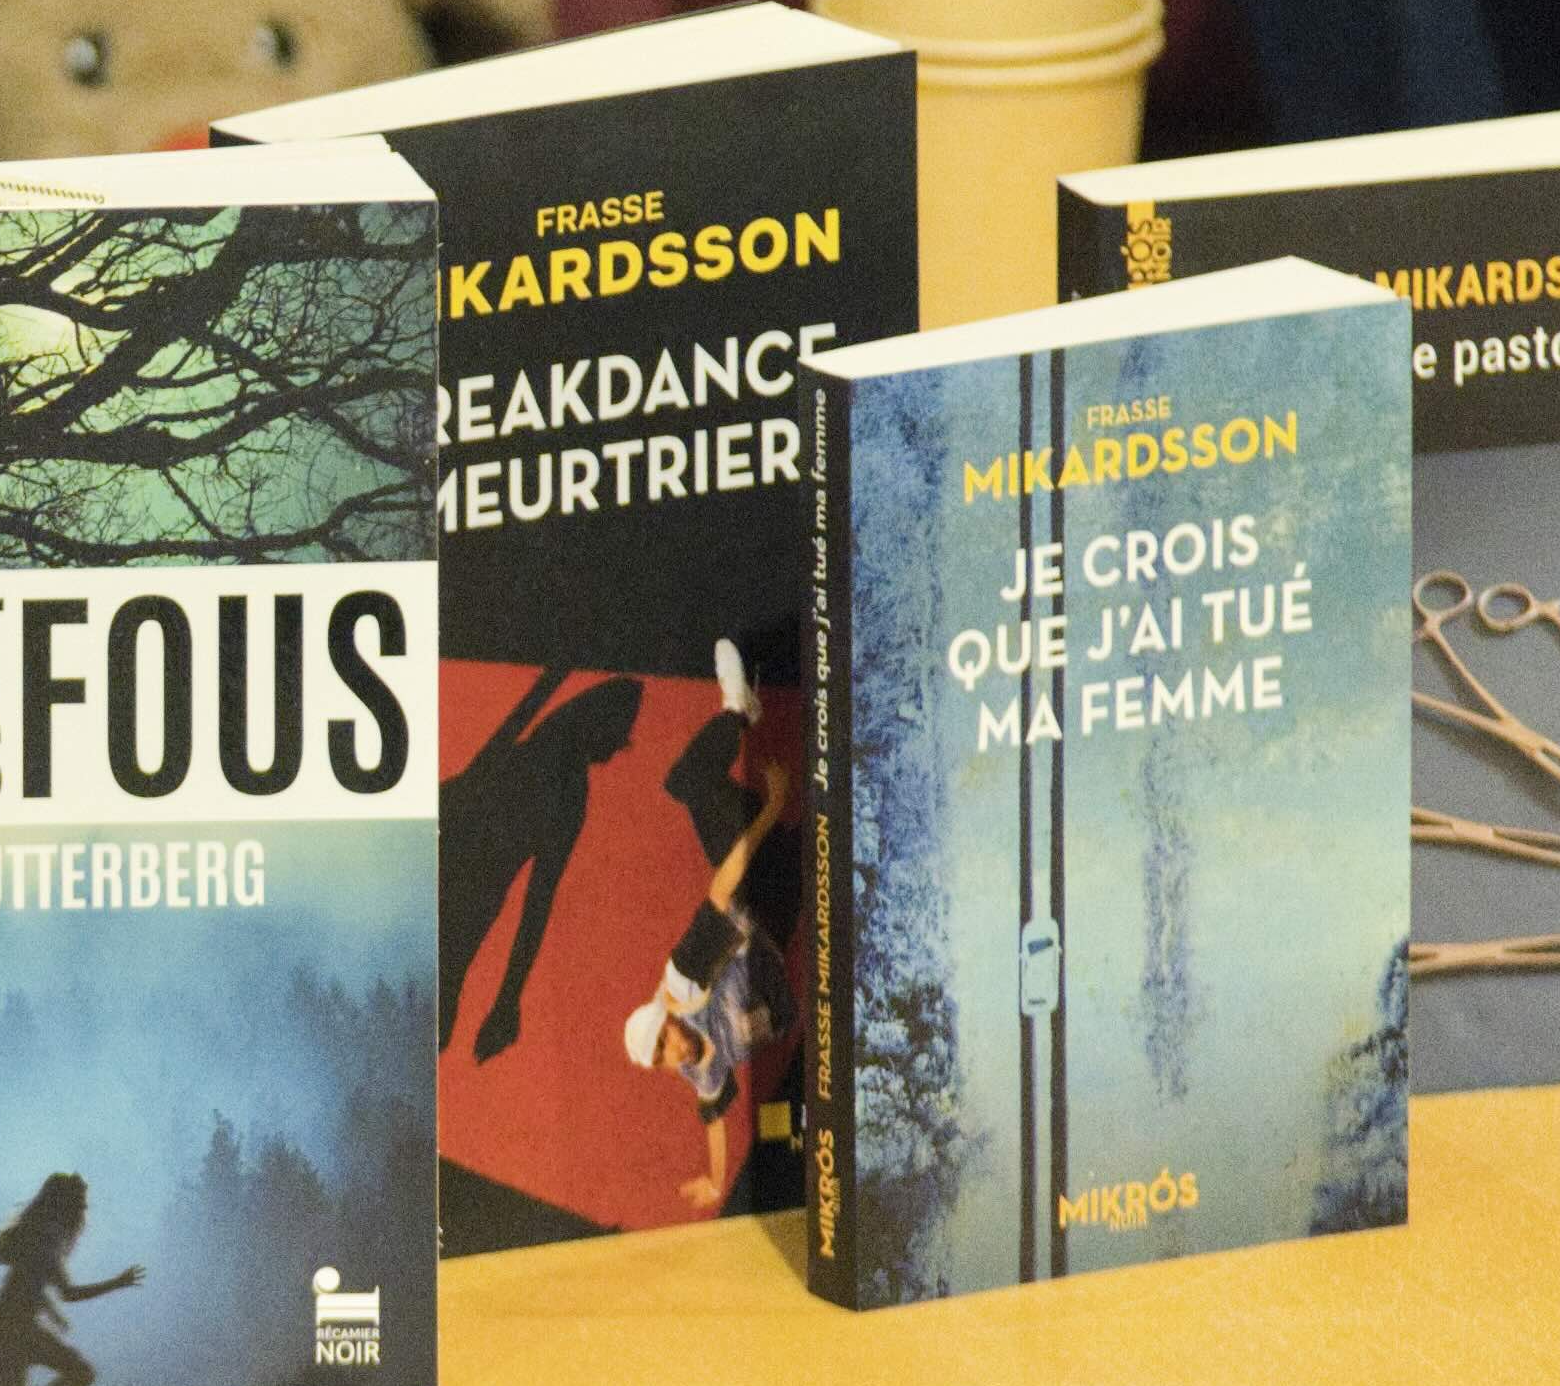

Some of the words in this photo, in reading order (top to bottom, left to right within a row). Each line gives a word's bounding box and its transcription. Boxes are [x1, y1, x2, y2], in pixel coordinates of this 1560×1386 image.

[537, 190, 664, 237] FRASSE
[436, 208, 841, 321] KARDSSON
[437, 322, 836, 446] REAKDANC
[1087, 395, 1171, 429] FRASSE
[811, 388, 827, 482] femme
[963, 410, 1297, 504] MIKARDSSON
[815, 489, 827, 531] ma
[812, 536, 828, 580] tué
[1001, 543, 1063, 601] JE
[1083, 515, 1259, 587] CROIS
[816, 630, 831, 681] que
[948, 615, 1068, 691] QUE
[1087, 597, 1182, 660] J'AI
[1201, 561, 1313, 643] TUÉ
[22, 590, 410, 799] FOUS
[813, 687, 829, 753] crois
[978, 692, 1063, 752] MA
[1082, 656, 1283, 735] FEMME
[813, 757, 829, 792] Je
[816, 813, 831, 995] MIKARDSSON
[816, 999, 832, 1101] FRASSE
[816, 1129, 834, 1260] MIKRÓS
[1059, 1165, 1200, 1230] MIKRÓS
[315, 1340, 381, 1364] NOIR
